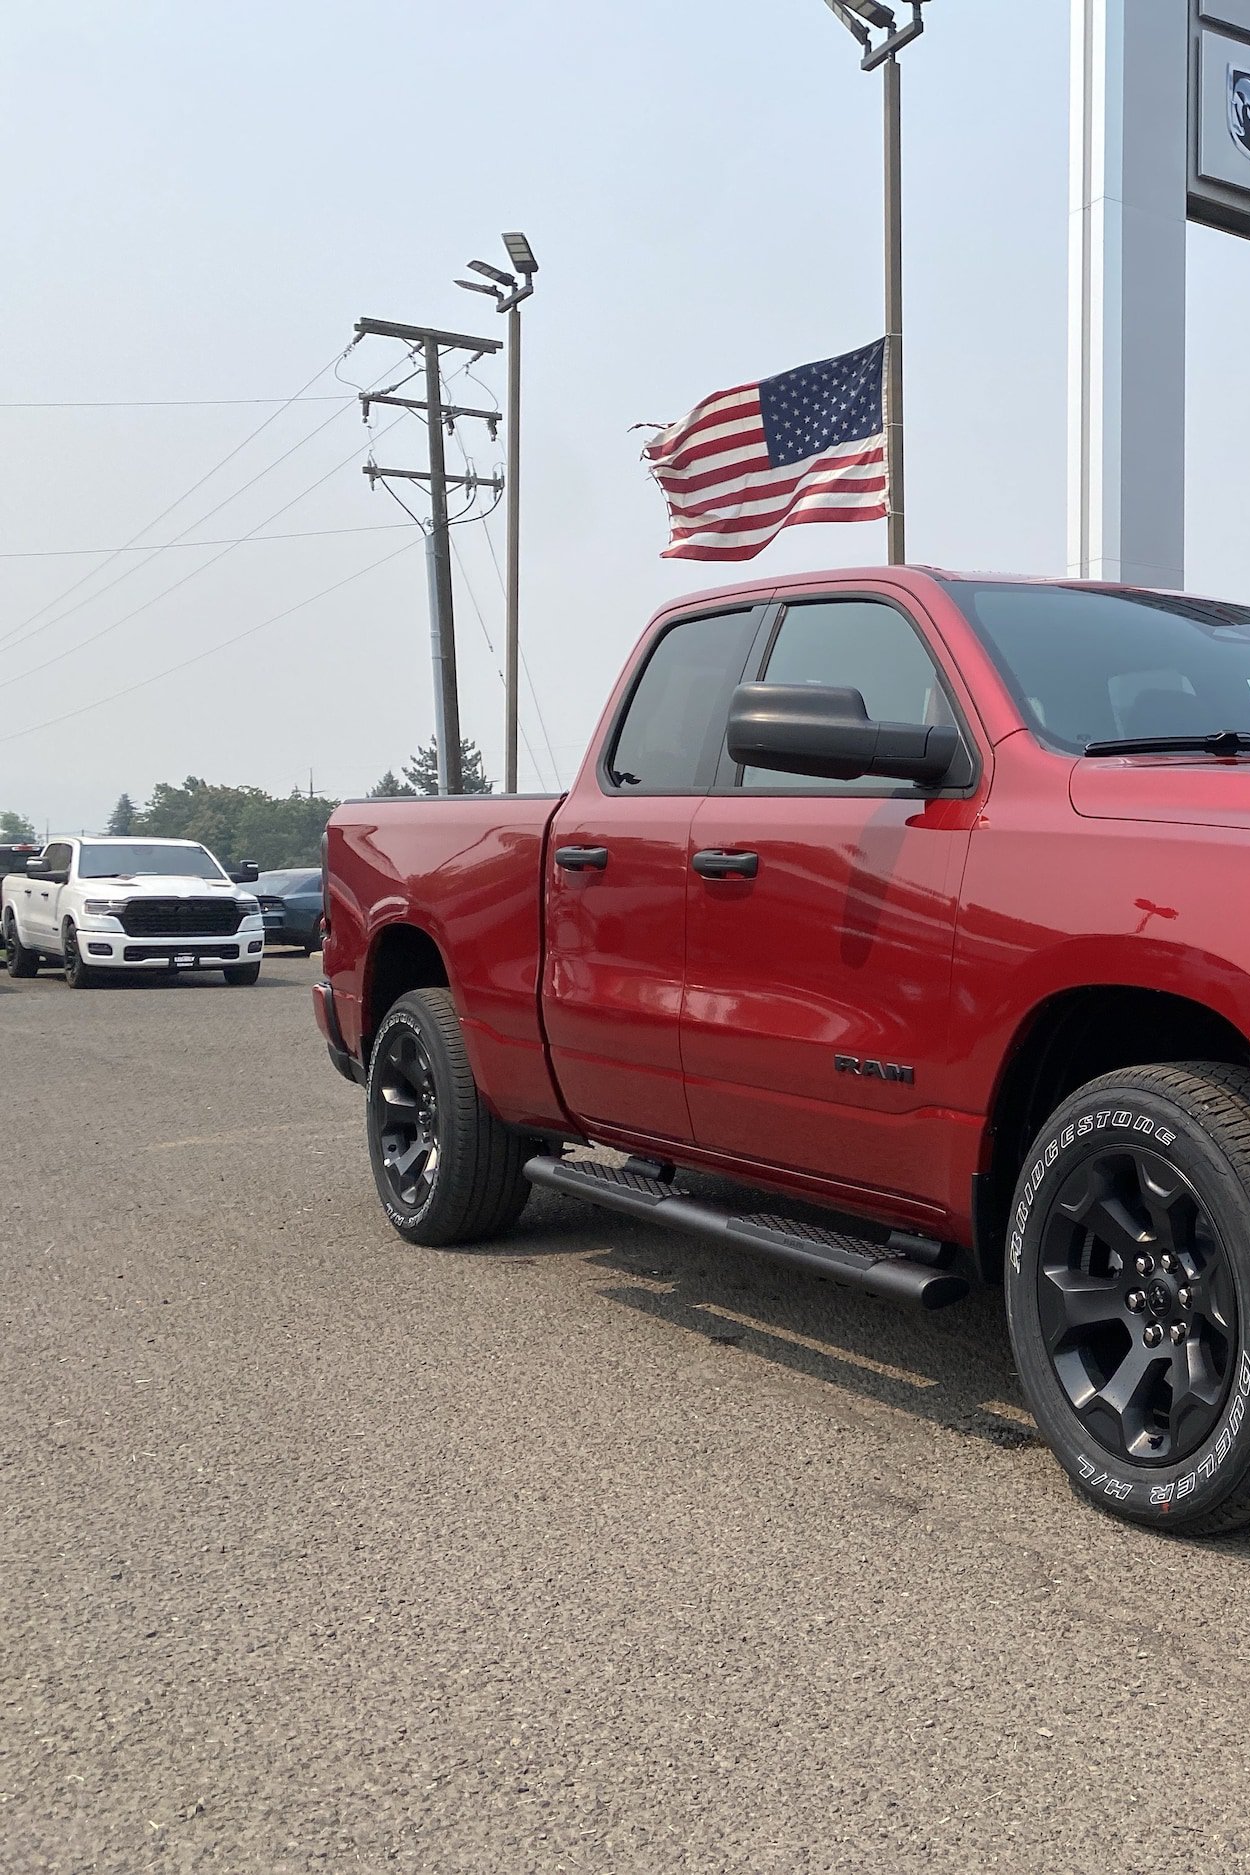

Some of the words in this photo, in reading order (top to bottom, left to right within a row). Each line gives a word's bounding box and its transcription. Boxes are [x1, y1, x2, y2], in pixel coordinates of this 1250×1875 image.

[834, 1053, 915, 1086] RAM
[1010, 1110, 1177, 1275] BRIDGESTONE
[1077, 1454, 1134, 1501] H/L
